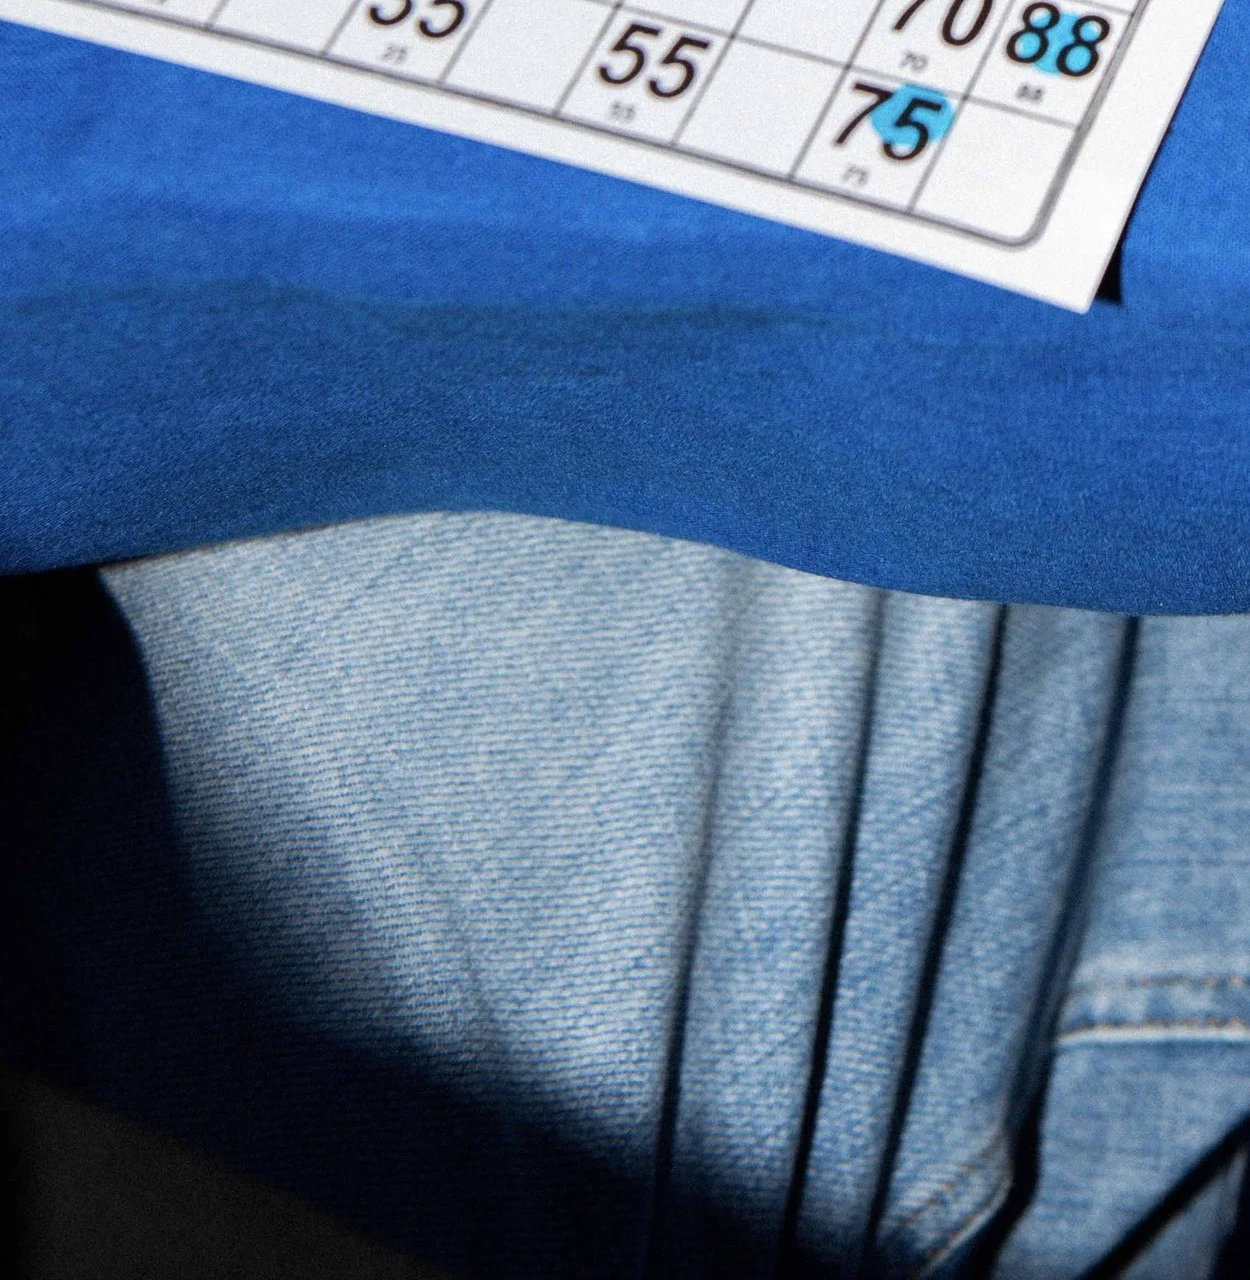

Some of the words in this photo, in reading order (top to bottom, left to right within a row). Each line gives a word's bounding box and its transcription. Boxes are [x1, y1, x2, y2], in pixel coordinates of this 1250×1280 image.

[599, 23, 710, 99] 55
[1005, 1, 1111, 78] 88
[835, 82, 942, 161] 75
